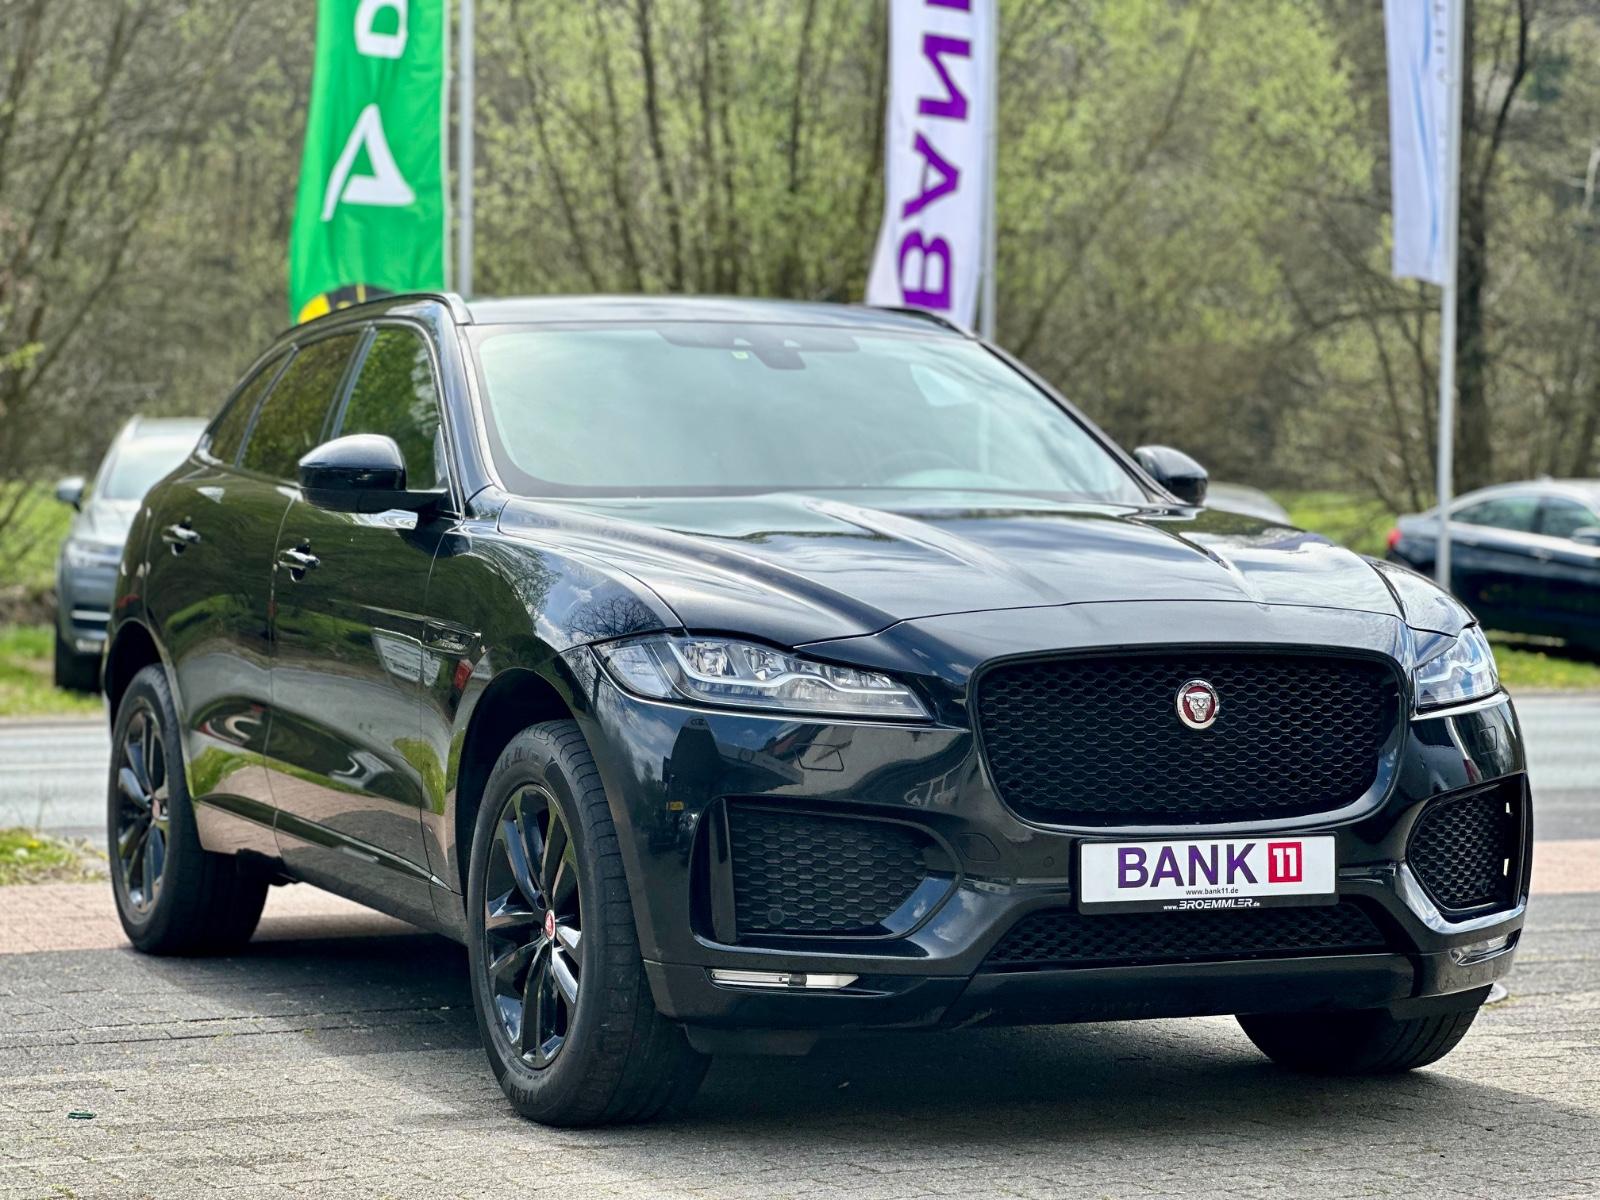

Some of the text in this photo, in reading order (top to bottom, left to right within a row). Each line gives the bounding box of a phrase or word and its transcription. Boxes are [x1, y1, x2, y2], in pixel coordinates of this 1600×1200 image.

[1117, 843, 1299, 889] BANK 11
[1186, 887, 1239, 895] www.bank11.de
